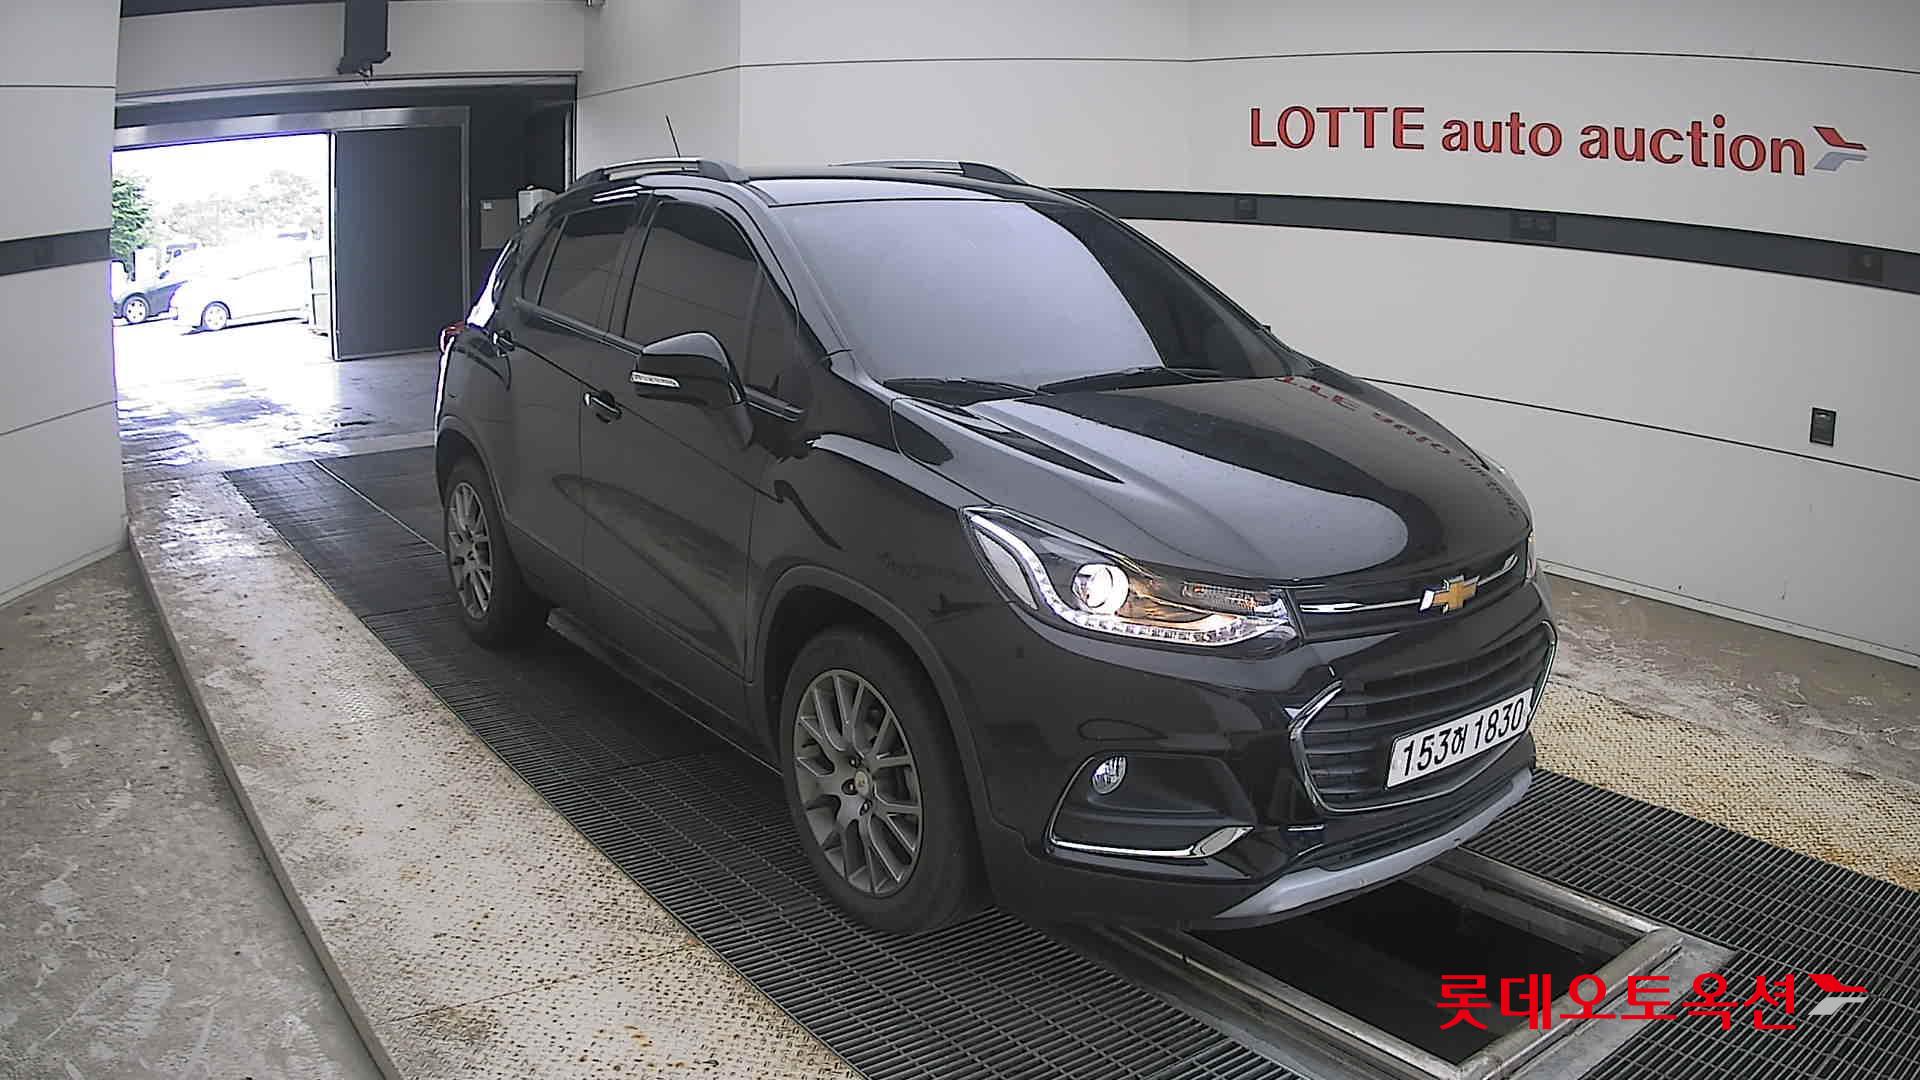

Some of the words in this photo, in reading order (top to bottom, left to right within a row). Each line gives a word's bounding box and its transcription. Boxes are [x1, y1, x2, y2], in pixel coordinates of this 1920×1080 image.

[1250, 107, 1425, 150] LOTTE
[1441, 111, 1563, 156] auto
[1579, 114, 1806, 176] auction
[1403, 723, 1469, 776] 153허
[1474, 698, 1524, 749] 1830
